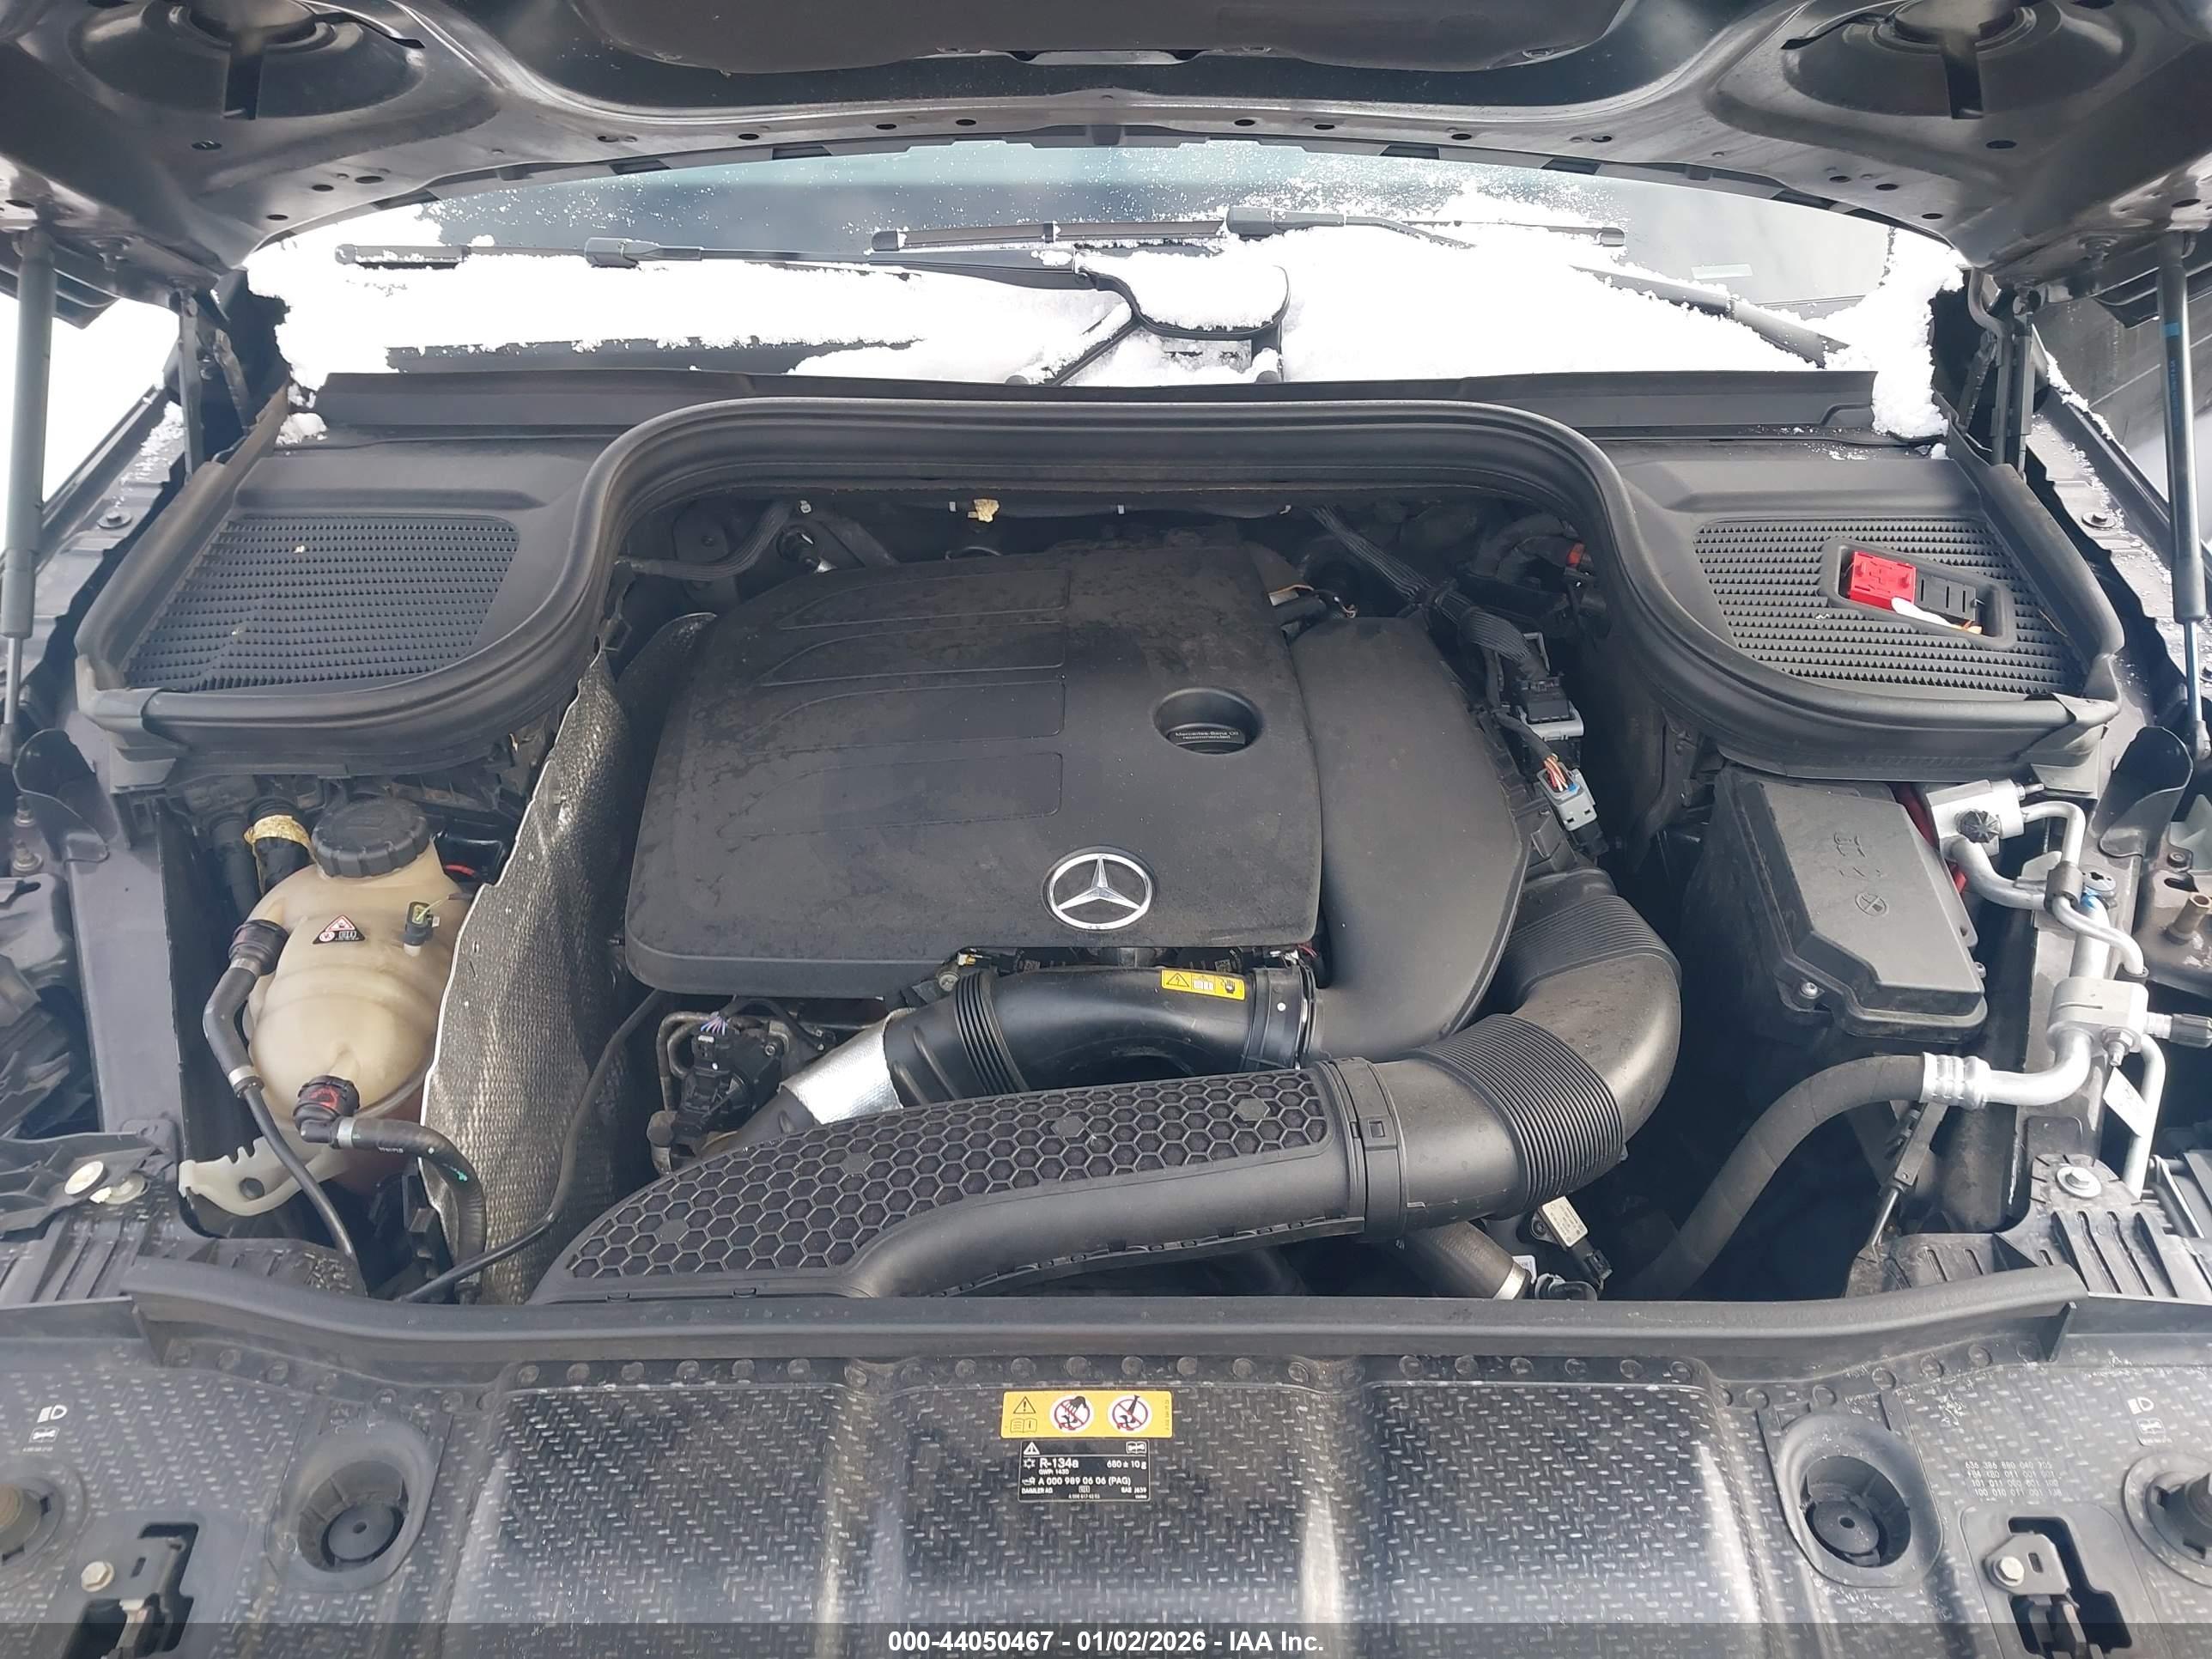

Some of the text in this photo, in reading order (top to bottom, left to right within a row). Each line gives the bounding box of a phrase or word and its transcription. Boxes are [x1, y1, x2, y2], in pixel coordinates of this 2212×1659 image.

[1038, 1457, 1079, 1469] R-134a
[1106, 1461, 1123, 1469] 680
[1131, 1461, 1139, 1469] 10
[1140, 1462, 1147, 1470] g
[1037, 1476, 1131, 1486] A 000 989 06 06 (PAG)
